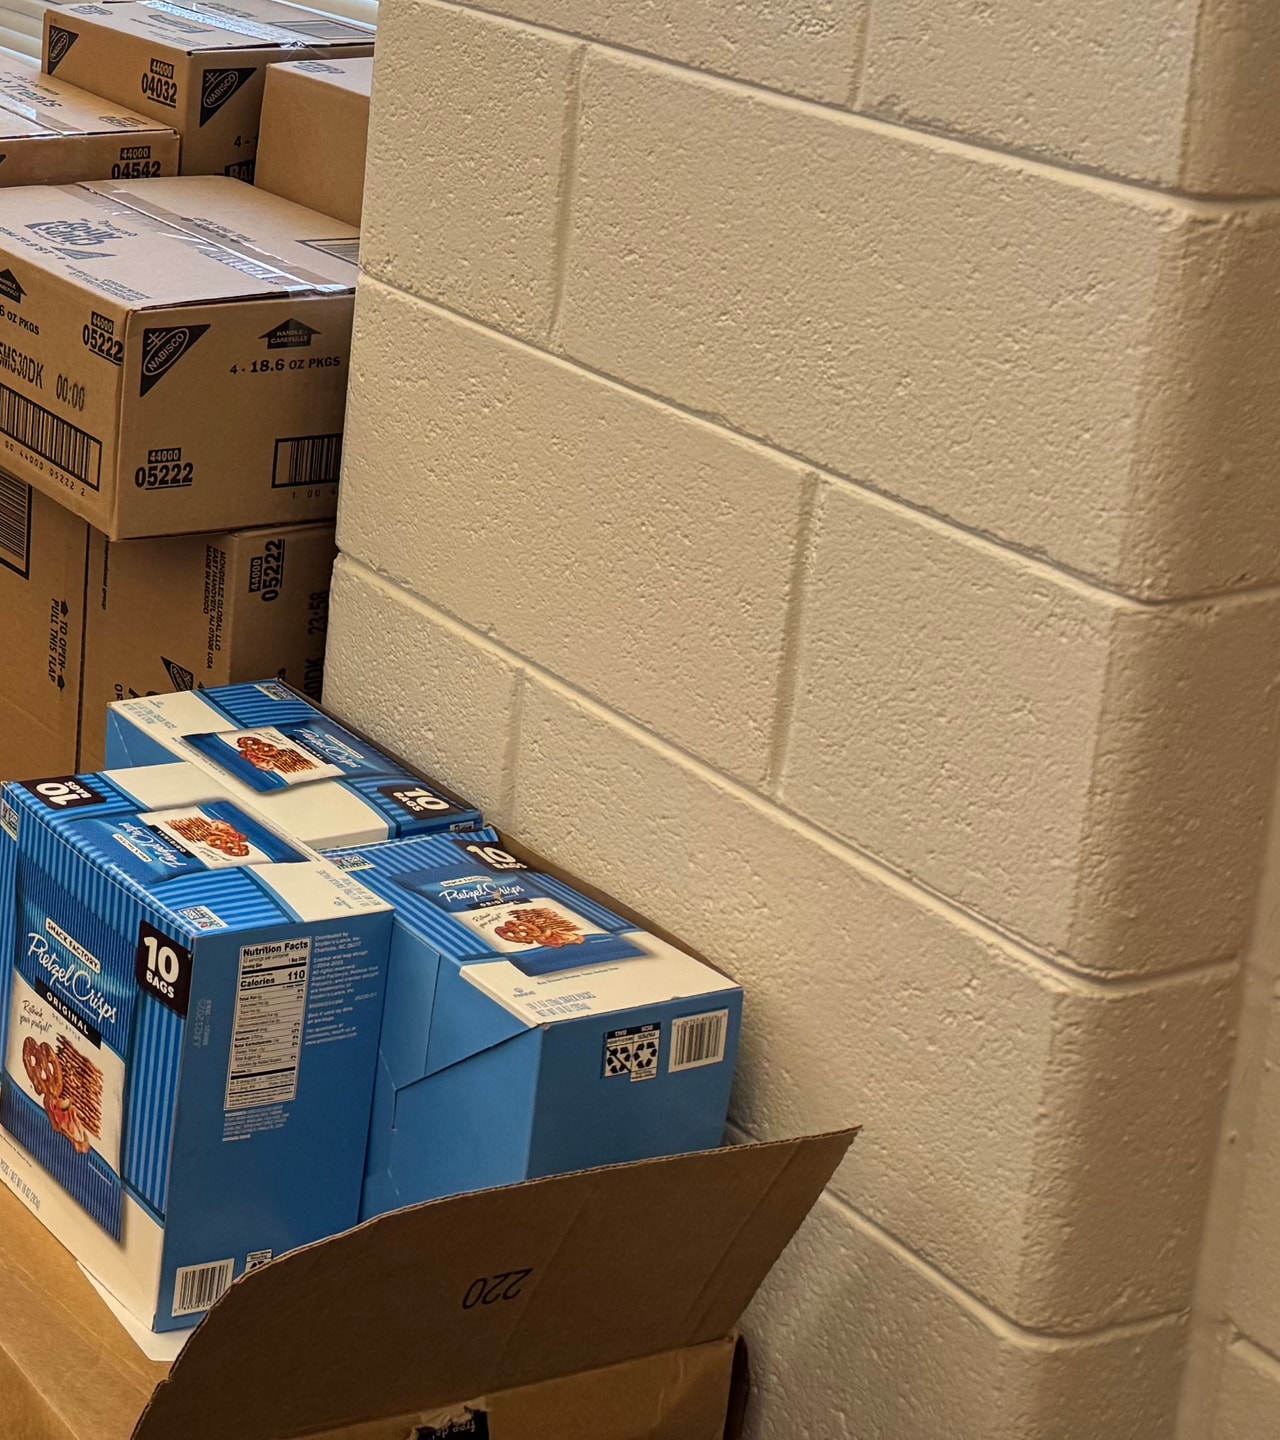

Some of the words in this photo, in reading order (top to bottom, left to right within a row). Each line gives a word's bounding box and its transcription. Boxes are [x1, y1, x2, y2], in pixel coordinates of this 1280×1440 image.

[141, 73, 177, 104] 04032
[206, 73, 238, 106] NABISCO
[121, 147, 150, 160] 44000
[111, 161, 161, 179] 04542
[7, 311, 17, 323] OZ
[18, 317, 40, 336] PKGS
[82, 324, 124, 363] 05222
[148, 332, 185, 372] NABISCO
[230, 365, 238, 375] 4
[250, 358, 285, 373] 18.6
[289, 359, 305, 370] OZ
[308, 356, 341, 369] PKGS
[56, 374, 85, 411] 00:00
[149, 448, 180, 462] 44000
[19, 449, 44, 471] 44000
[49, 468, 75, 491] 05222
[135, 462, 194, 490] 05222
[251, 559, 262, 590] 44000
[262, 539, 285, 602] 05222
[51, 598, 60, 625] PULL
[49, 627, 58, 652] THIS
[59, 620, 68, 637] TO
[47, 653, 57, 682] FLAP
[36, 781, 69, 806] 10
[64, 780, 93, 799] BAGS
[392, 790, 426, 813] BAGS
[401, 786, 451, 812] 10
[466, 845, 516, 863] 10
[439, 884, 487, 903] Pretzel
[46, 920, 69, 946] SNACK
[68, 938, 100, 973] FACTORY
[143, 936, 180, 984] 10
[243, 943, 282, 957] Nutrition
[284, 939, 309, 951] Facts
[28, 932, 75, 988] Pretzel
[73, 971, 117, 1024] Crisps
[146, 971, 176, 1000] BAGS
[240, 976, 276, 988] Calories
[287, 969, 306, 981] 110
[46, 993, 89, 1035] ORIGINAL
[462, 1267, 534, 1309] 220
